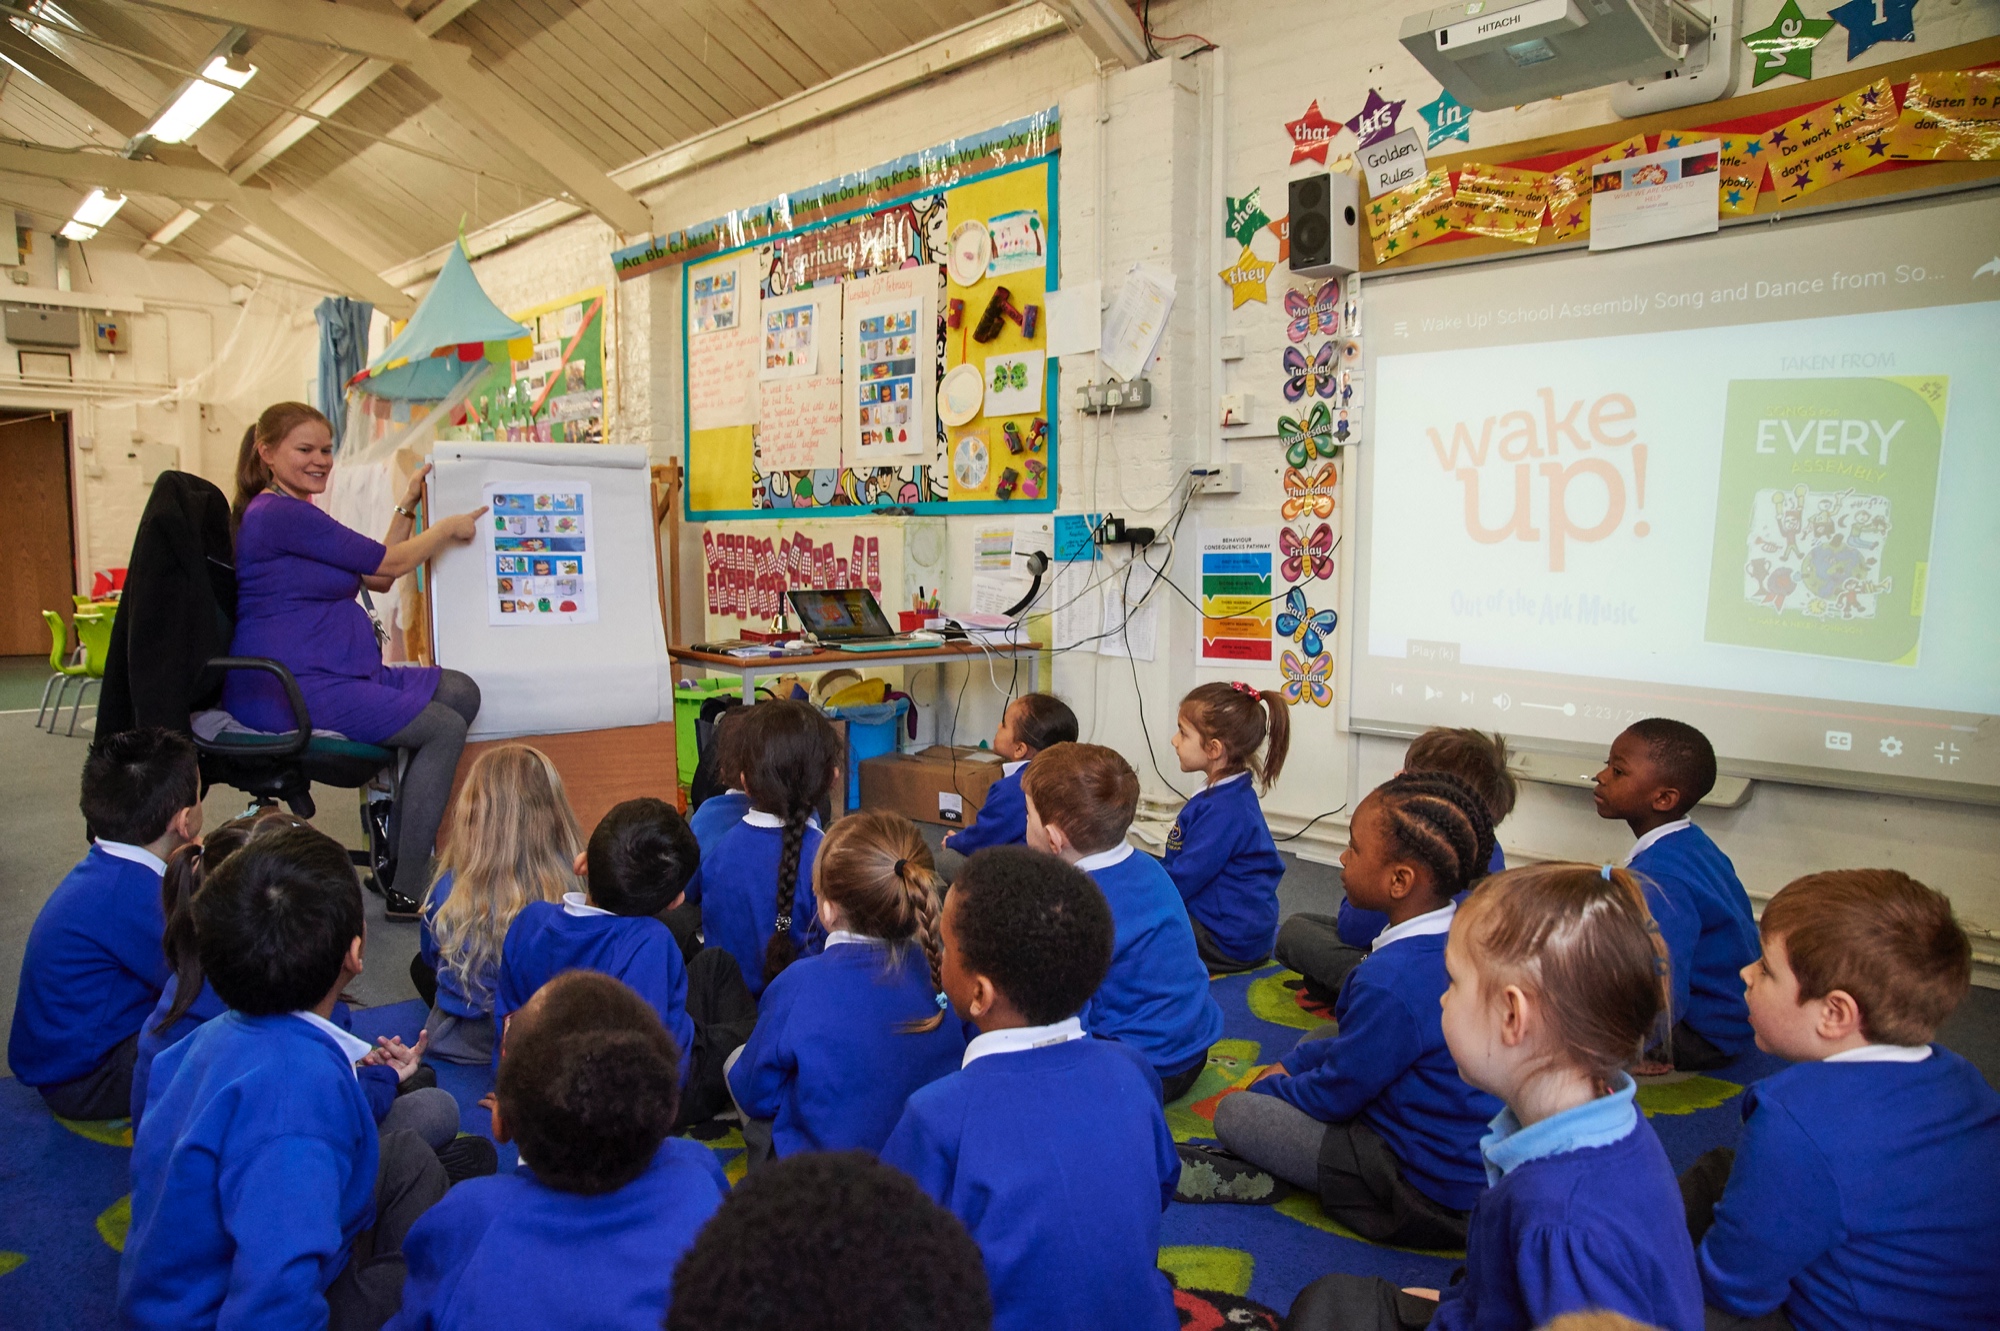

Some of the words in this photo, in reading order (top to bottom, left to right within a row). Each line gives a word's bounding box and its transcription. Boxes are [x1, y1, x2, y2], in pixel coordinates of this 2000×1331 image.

[1477, 14, 1521, 35] HITACHI
[1926, 96, 1966, 108] listen
[1973, 95, 1987, 106] to
[1358, 110, 1393, 136] his
[1437, 102, 1463, 127] in
[1294, 125, 1331, 141] that
[1781, 143, 1798, 157] Do
[1802, 129, 1832, 148] work
[1836, 113, 1868, 132] hard
[1367, 142, 1418, 168] Golden
[1781, 158, 1811, 178] don't
[1815, 142, 1852, 164] waste
[1380, 165, 1414, 188] Rules
[1720, 176, 1757, 191] ybody.
[622, 255, 641, 270] Aa
[646, 247, 664, 262] Bb
[801, 198, 819, 212] Mm
[823, 192, 837, 205] Nn
[840, 186, 854, 200] Oo
[858, 181, 873, 195] Pp
[875, 175, 890, 191] Qq
[892, 171, 904, 185] Rr
[907, 164, 921, 180] Ss
[959, 147, 976, 163] Vv
[1008, 132, 1024, 149] Xx
[1472, 184, 1483, 192] be
[1486, 186, 1515, 198] honest
[1526, 192, 1549, 202] don't
[1614, 191, 1633, 200] WHAT
[1634, 189, 1645, 197] WE
[1661, 182, 1684, 193] DOING
[1685, 180, 1695, 189] TO
[1644, 194, 1662, 203] HELP
[1231, 202, 1256, 234] she
[1371, 230, 1387, 243] hurt
[1421, 200, 1454, 219] feelings
[1375, 216, 1386, 227] Do
[1455, 200, 1478, 210] cover
[1495, 205, 1509, 215] the
[1514, 207, 1537, 219] truth
[784, 241, 854, 274] Learning
[1229, 266, 1266, 285] they
[846, 283, 871, 304] Tuesday
[886, 274, 913, 298] February
[1421, 317, 1462, 333] Wake
[1467, 312, 1491, 331] Up!
[1497, 304, 1555, 325] School
[1559, 294, 1649, 320] Assembly
[1654, 290, 1704, 310] Song
[1711, 283, 1748, 303] and
[1755, 278, 1824, 299] Dance
[1832, 271, 1887, 291] from
[1895, 265, 1945, 283] So...
[1292, 301, 1334, 318] Monday
[1290, 363, 1331, 377] Tuesday
[1780, 355, 1835, 372] TAKEN
[1841, 352, 1897, 369] FROM
[1280, 422, 1333, 447] Wednesday
[1426, 387, 1638, 472] wake
[1756, 419, 1906, 465] EVERY
[1792, 459, 1888, 484] ASSEMBLY
[1287, 484, 1334, 497] Thursday
[1456, 443, 1651, 573] up!
[1290, 545, 1323, 558] Friday
[1450, 588, 1483, 618] Out
[1486, 587, 1505, 613] of
[1508, 587, 1537, 618] the
[1538, 592, 1574, 626] Ark
[1577, 592, 1640, 626] Music
[1285, 601, 1328, 640] Saturday
[1412, 645, 1436, 661] Play
[1438, 647, 1454, 662] (k)
[1288, 670, 1325, 685] Sunday
